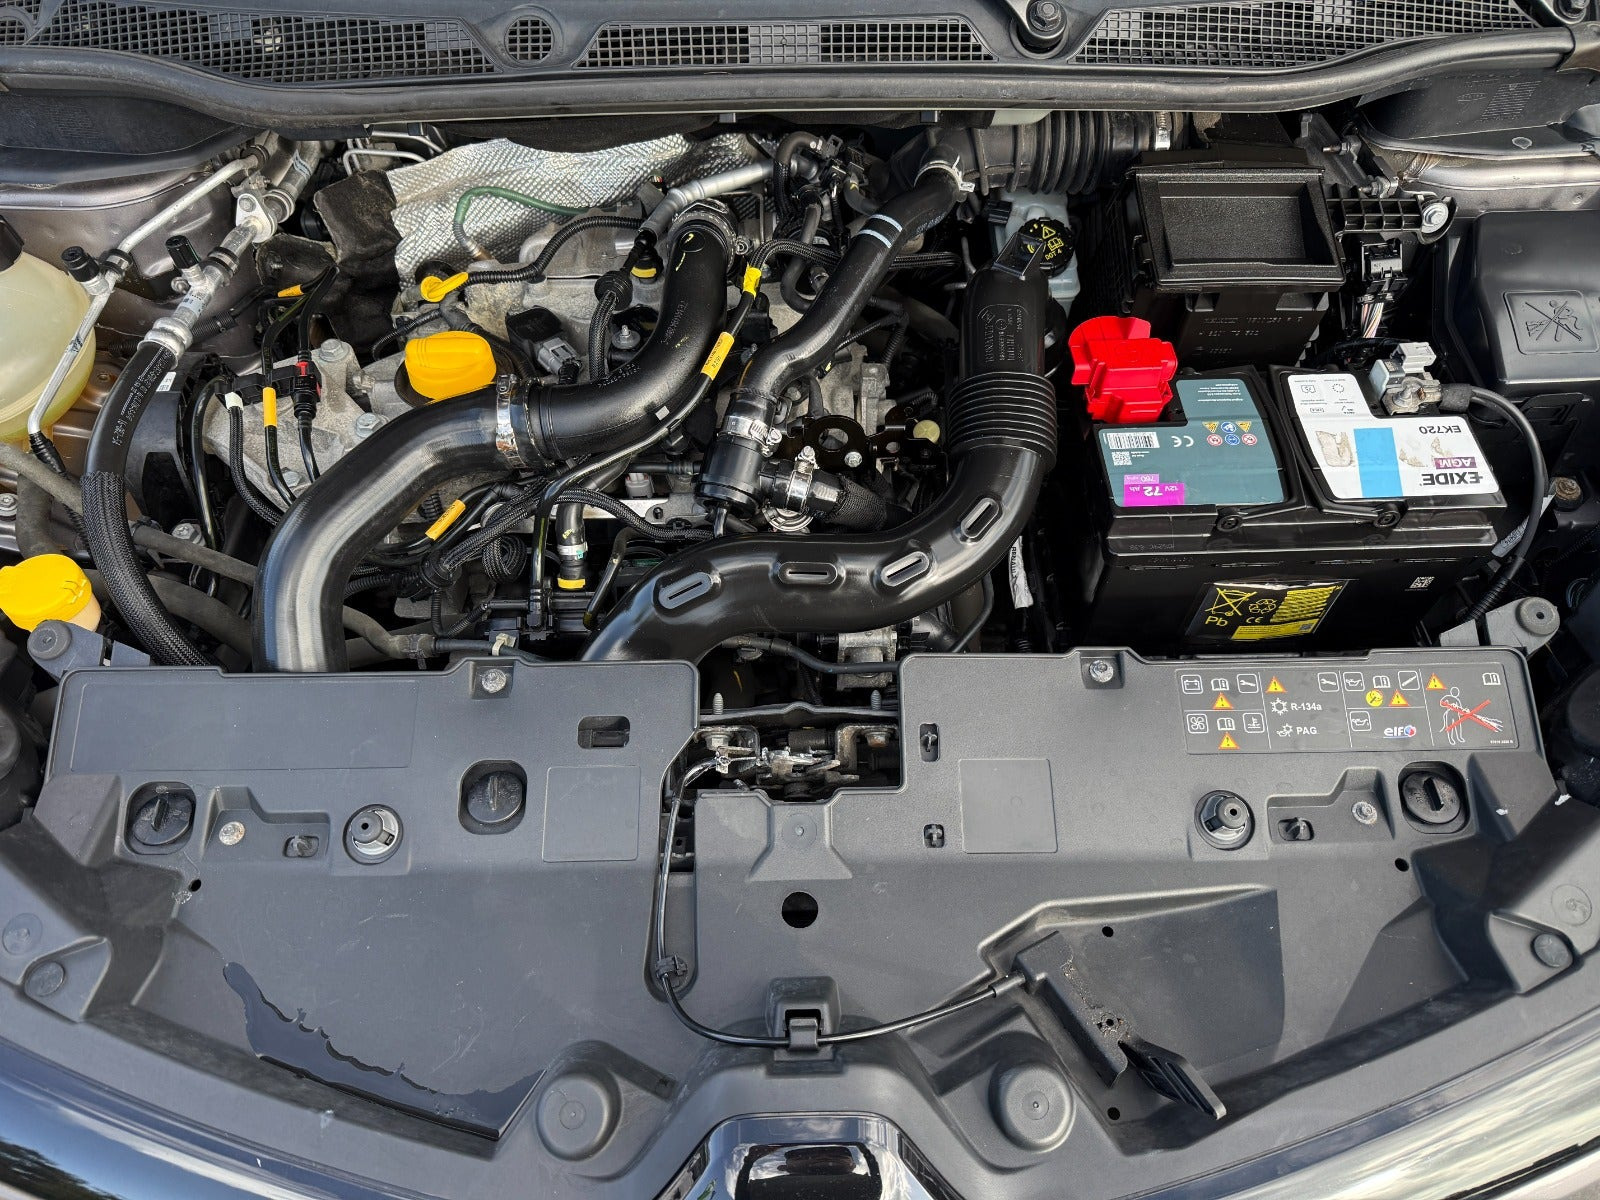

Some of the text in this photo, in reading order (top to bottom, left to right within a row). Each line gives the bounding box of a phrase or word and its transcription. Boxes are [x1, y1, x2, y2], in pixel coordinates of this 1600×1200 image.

[1045, 250, 1056, 260] DOT
[1419, 425, 1461, 434] EK720
[1439, 458, 1471, 468] AGM
[1421, 471, 1483, 486] EXIDE
[1143, 486, 1163, 496] 72
[1205, 615, 1228, 626] Pb
[1290, 702, 1322, 711] R-134a
[1296, 726, 1318, 735] PAG
